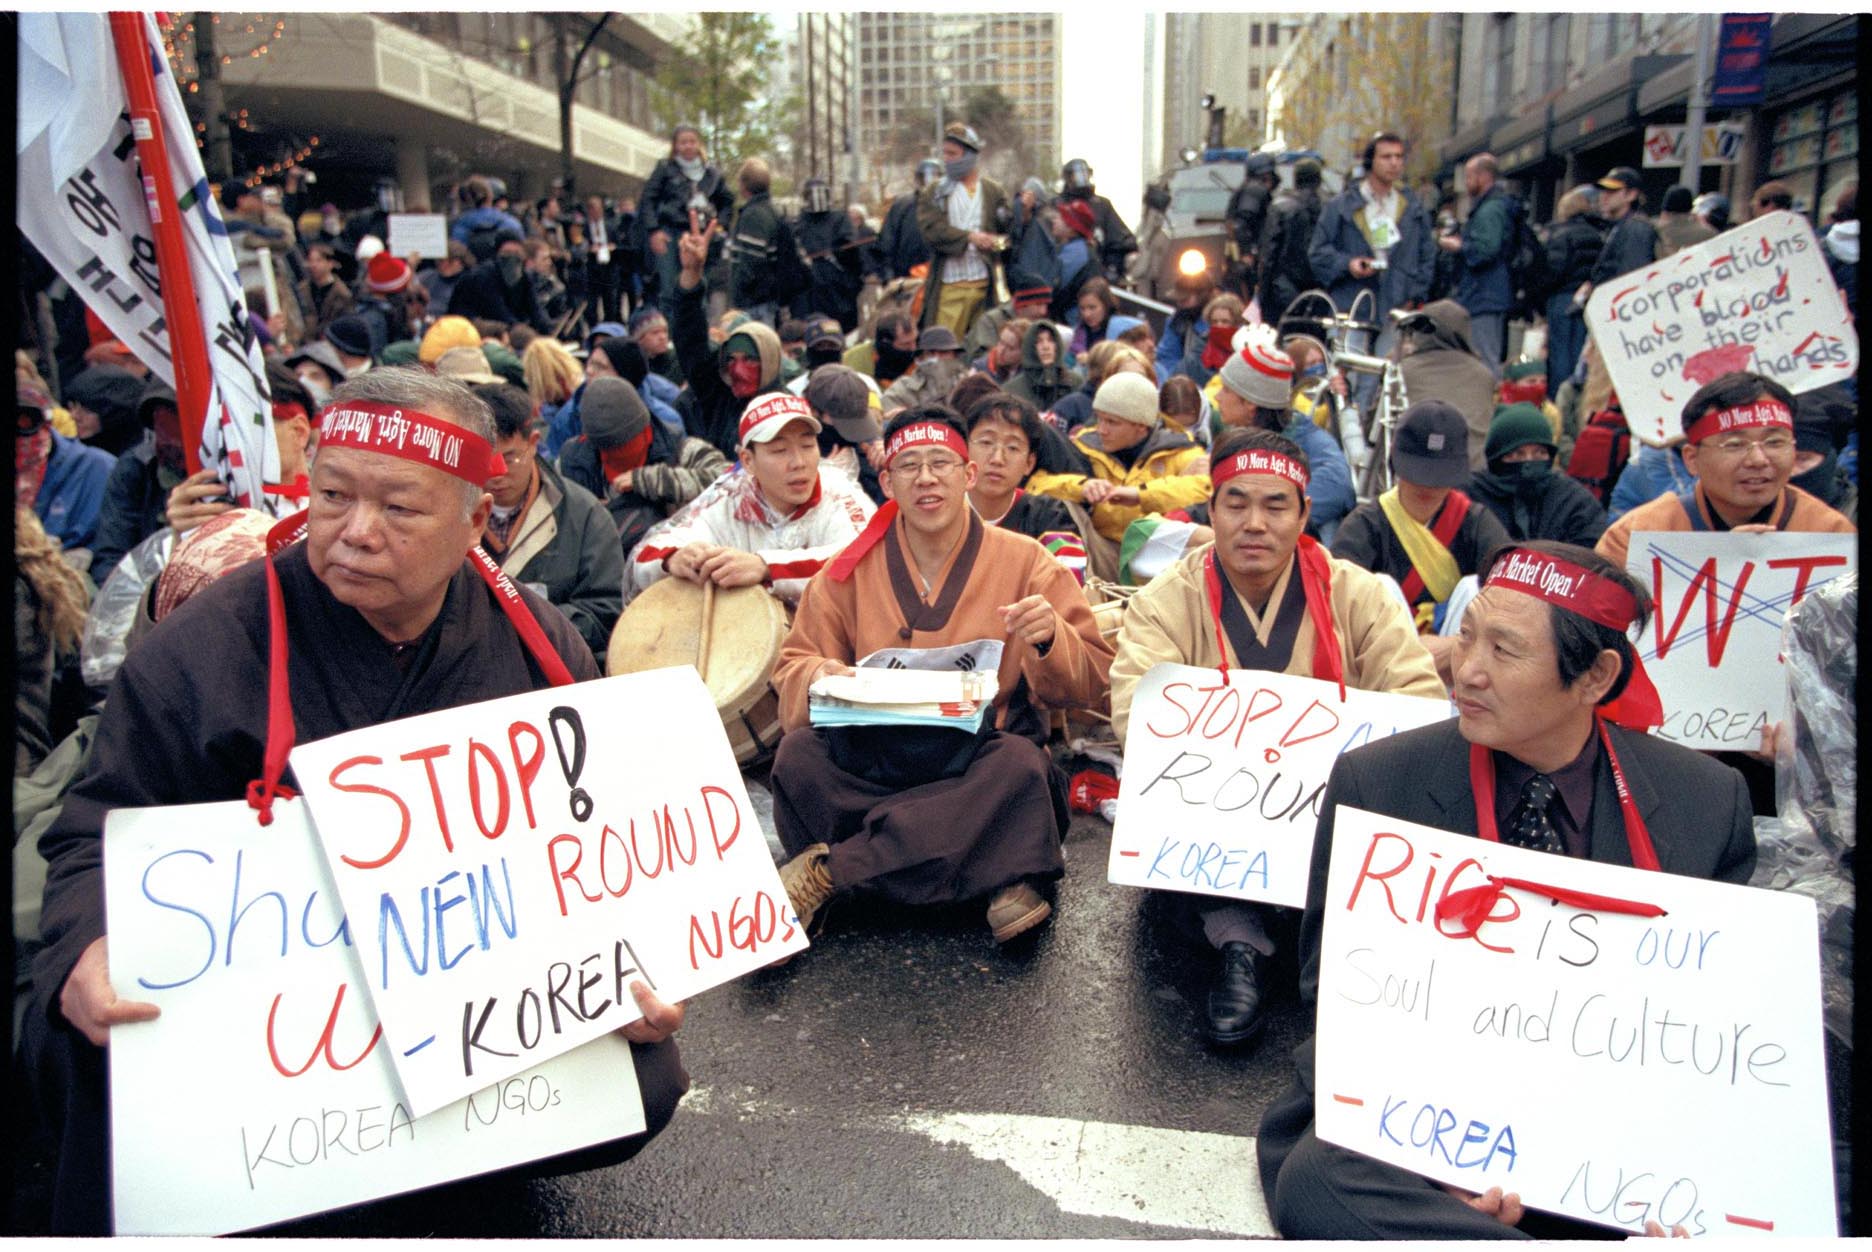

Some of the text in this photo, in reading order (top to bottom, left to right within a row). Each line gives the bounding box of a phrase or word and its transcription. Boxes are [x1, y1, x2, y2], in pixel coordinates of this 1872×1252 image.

[1617, 233, 1809, 323] corporations
[1620, 264, 1791, 359] have blood
[1651, 308, 1794, 378] on their
[1753, 337, 1848, 377] hands
[335, 408, 375, 443] Market
[376, 410, 411, 450] Agri.
[413, 424, 445, 460] More
[444, 435, 463, 468] NO
[904, 425, 926, 443] Market
[1236, 454, 1248, 472] NO
[1249, 452, 1269, 470] More
[1502, 553, 1541, 586] Market
[380, 786, 741, 990] NEW ROUND
[1147, 836, 1268, 890] KOREA
[1346, 832, 1521, 954] Rice
[1635, 924, 1720, 971] our
[461, 936, 658, 1077] KOREA
[689, 890, 795, 970] NGOs
[1336, 948, 1791, 1087] Soul and Culture
[241, 1101, 415, 1190] KOREA
[1377, 1094, 1519, 1174] KOREA
[1560, 1159, 1707, 1237] NGOs
